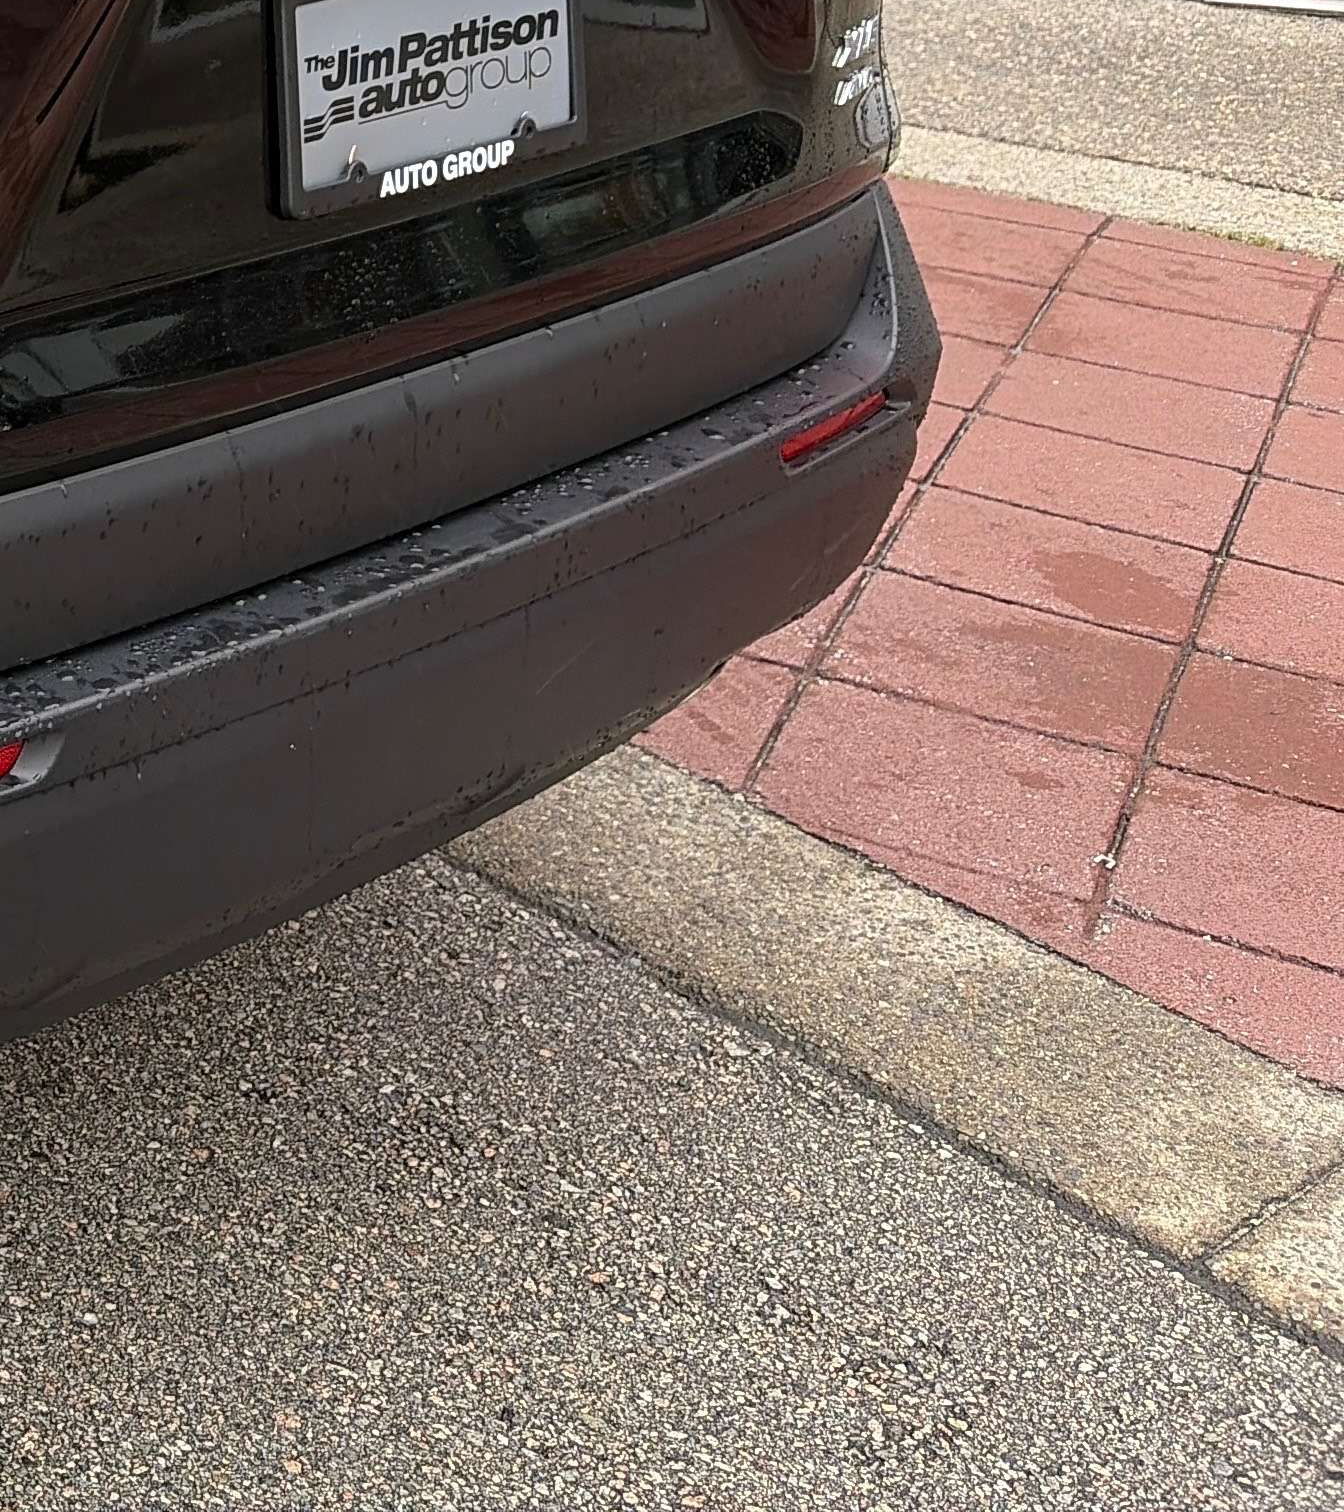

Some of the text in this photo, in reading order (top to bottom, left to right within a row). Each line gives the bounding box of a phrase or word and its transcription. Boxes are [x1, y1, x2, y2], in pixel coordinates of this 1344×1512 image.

[304, 7, 560, 92] The Jim Pattison
[380, 138, 515, 199] AUTO GROUP
